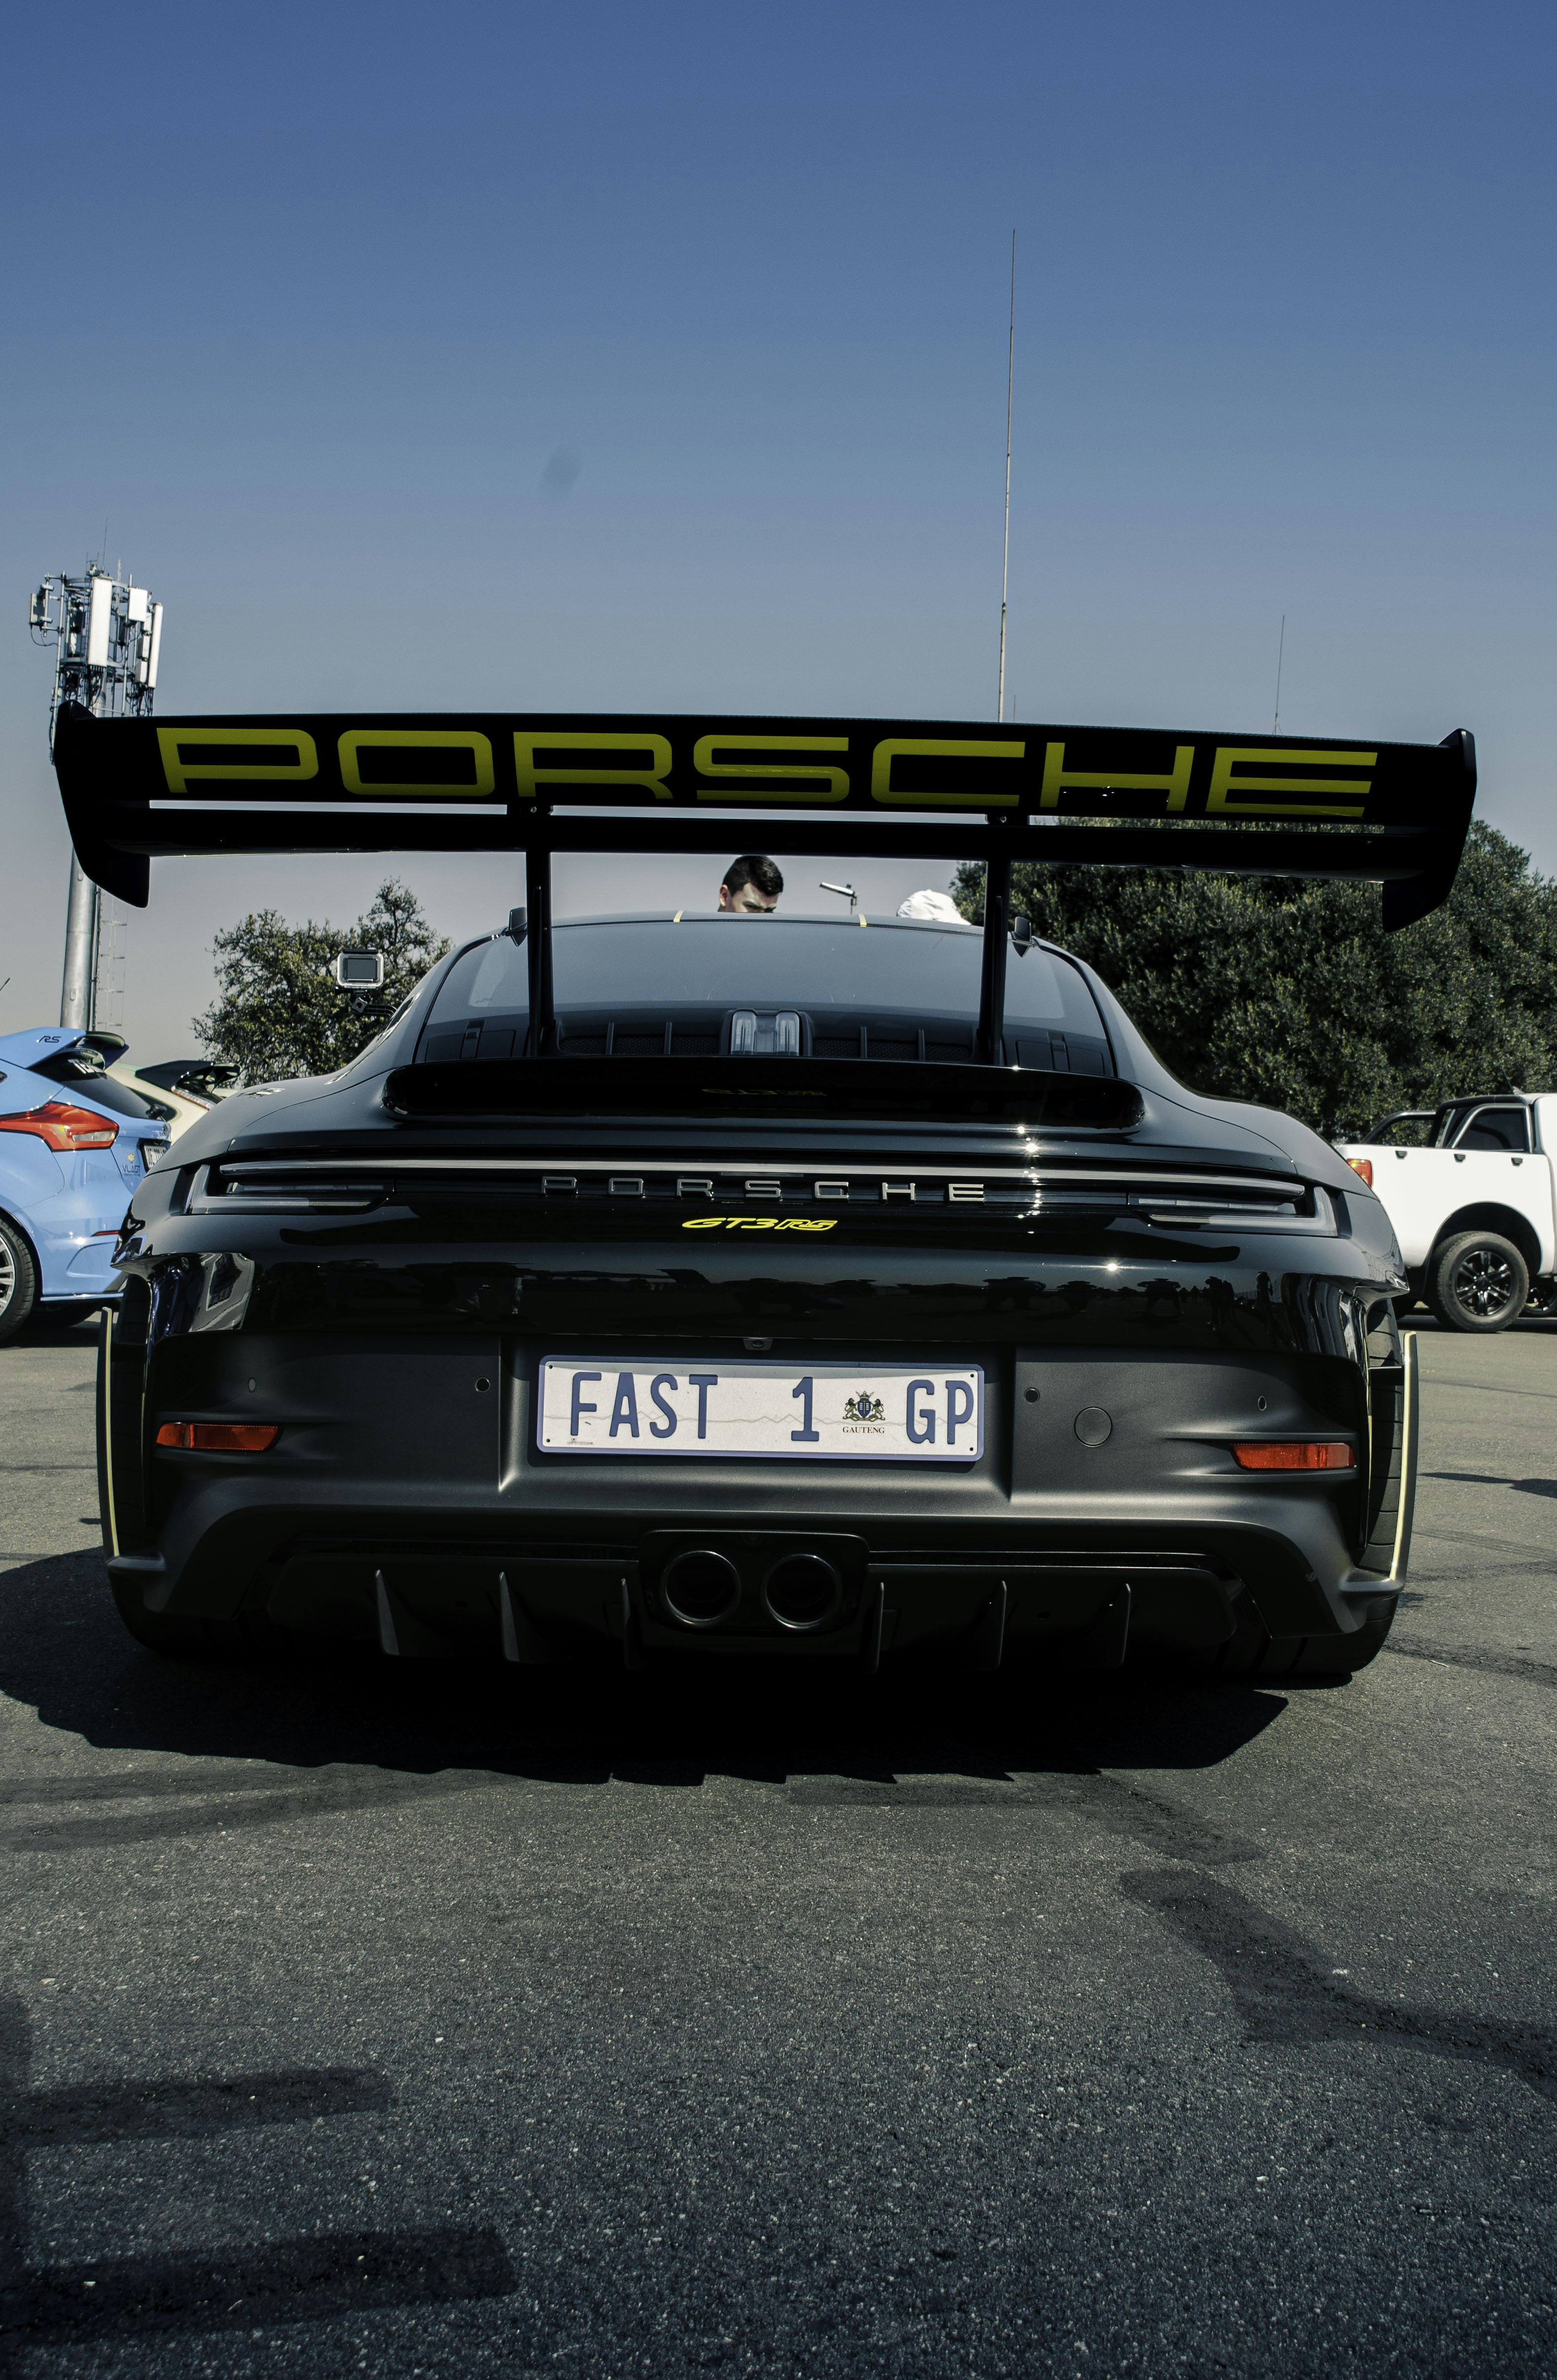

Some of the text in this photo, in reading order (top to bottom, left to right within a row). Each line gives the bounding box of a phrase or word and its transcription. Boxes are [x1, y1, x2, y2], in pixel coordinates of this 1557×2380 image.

[156, 727, 1378, 817] PORSCHE
[541, 1176, 985, 1202] PORSCHE
[570, 1372, 974, 1445] FAST 1 GP
